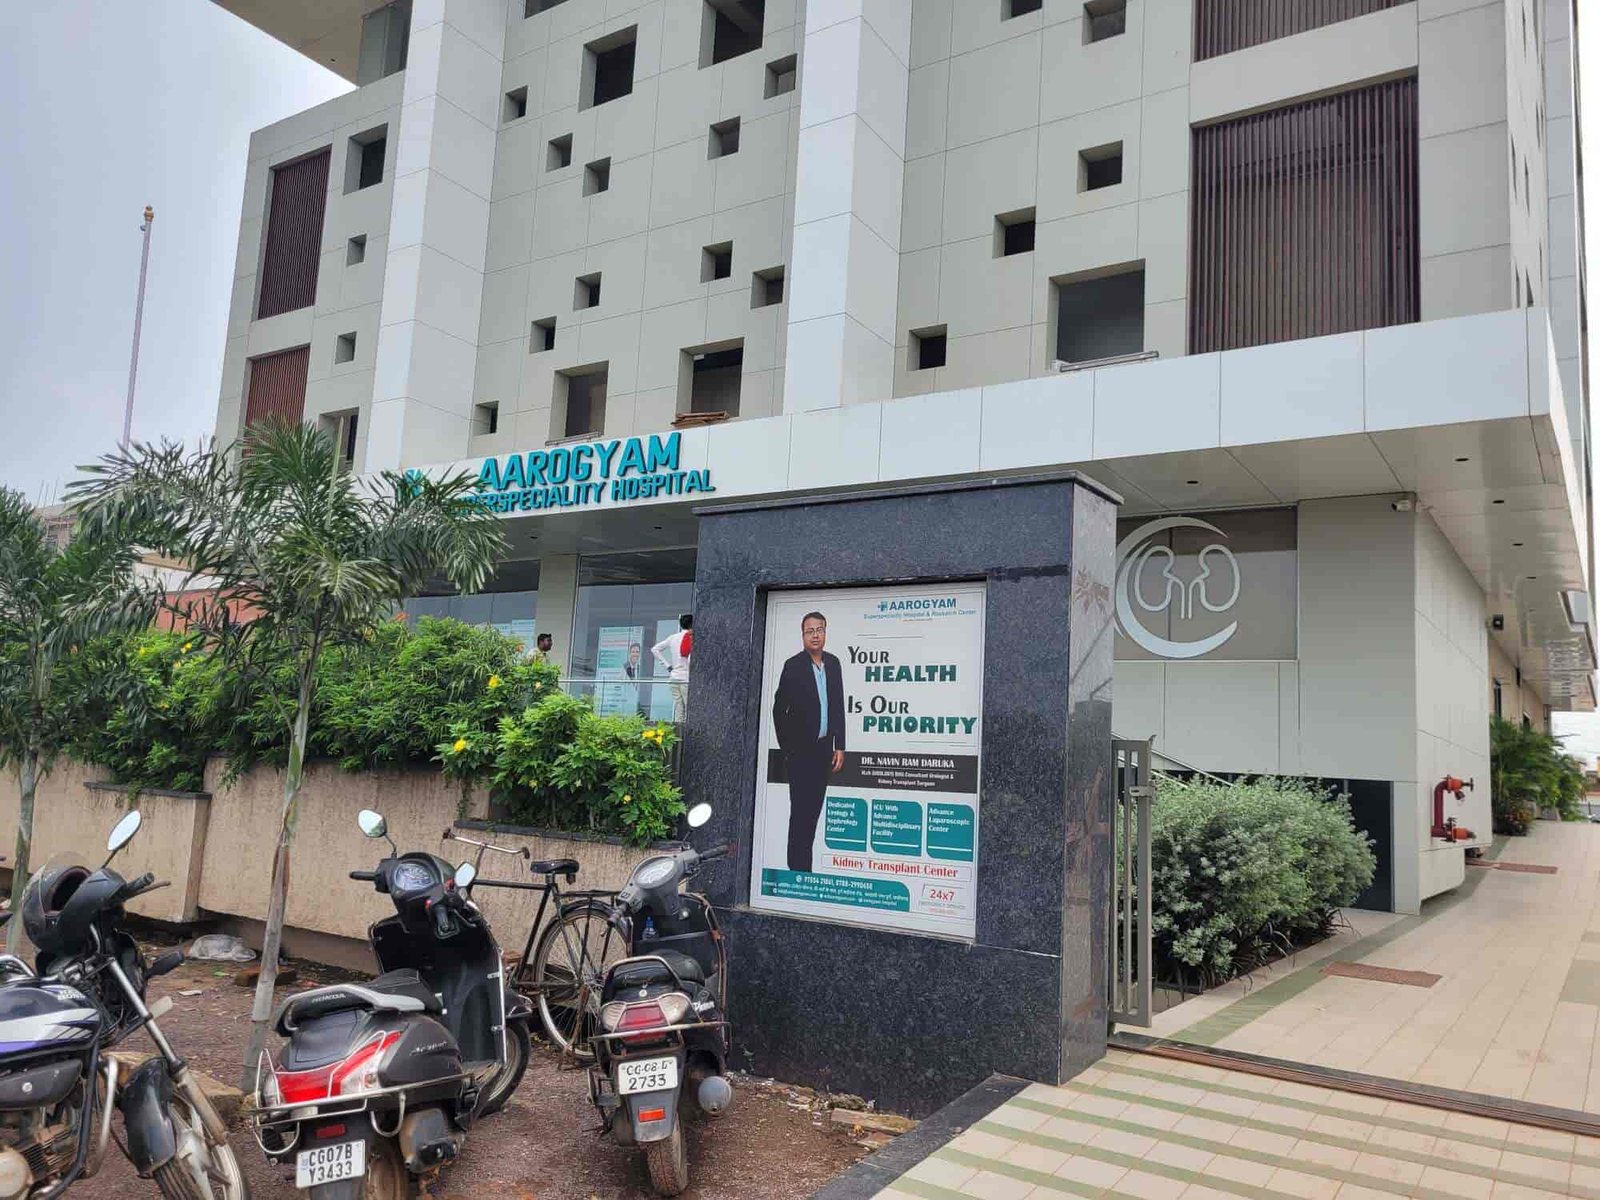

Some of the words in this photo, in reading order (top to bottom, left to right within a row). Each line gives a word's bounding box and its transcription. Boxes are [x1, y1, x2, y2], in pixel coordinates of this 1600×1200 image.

[480, 432, 681, 491] AAROGYAM
[611, 469, 716, 501] HOSPITAL
[889, 598, 957, 611] AAROGYAM
[865, 665, 957, 682] HEALTH
[863, 716, 977, 734] PRIORITY
[861, 756, 875, 765] DR.
[877, 757, 899, 766] NAVIN
[902, 758, 919, 767] RAM
[827, 801, 855, 809] Dedicated
[885, 804, 898, 812] With
[827, 809, 848, 818] Urology
[873, 812, 897, 820] Advance
[928, 807, 954, 816] Advance
[827, 817, 858, 826] Nephrology
[873, 821, 921, 831] Multidisciplinary
[928, 816, 970, 825] Laparoscopic
[827, 825, 845, 833] Center
[872, 829, 893, 838] Facility
[928, 825, 949, 833] Center
[832, 856, 864, 870] Kidney
[867, 860, 922, 875] Transplant
[924, 865, 959, 878] Center
[929, 889, 955, 901] 24x7
[312, 992, 347, 1003] HONDA
[629, 1073, 666, 1091] 2733
[309, 1144, 353, 1167] CG07B
[309, 1161, 353, 1184] Y3433
